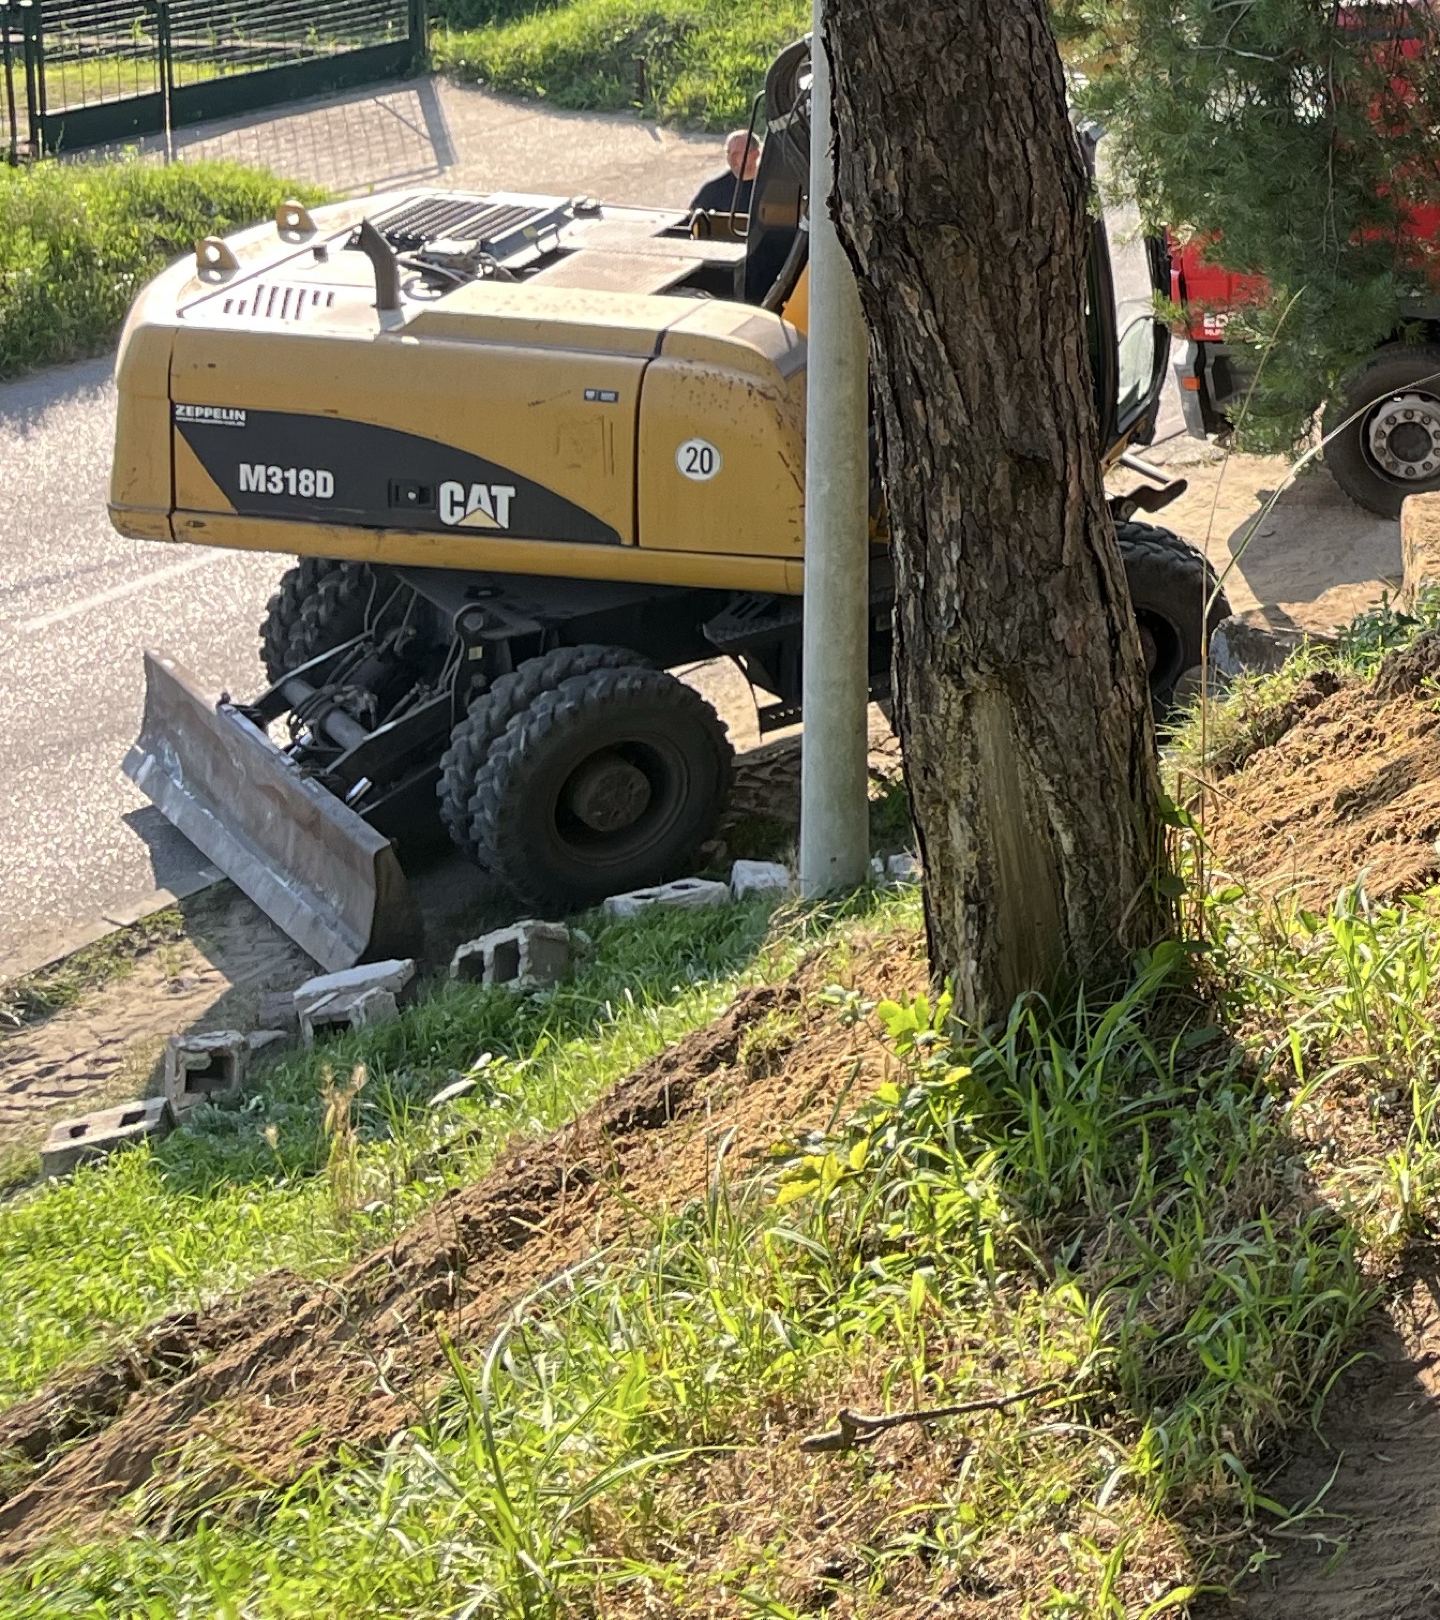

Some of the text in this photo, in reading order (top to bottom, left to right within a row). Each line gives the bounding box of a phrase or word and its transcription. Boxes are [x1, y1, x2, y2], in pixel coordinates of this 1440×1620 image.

[175, 404, 246, 422] ZEPPELIN
[686, 446, 713, 474] 20
[239, 463, 335, 499] M318D
[439, 480, 516, 529] CAT
